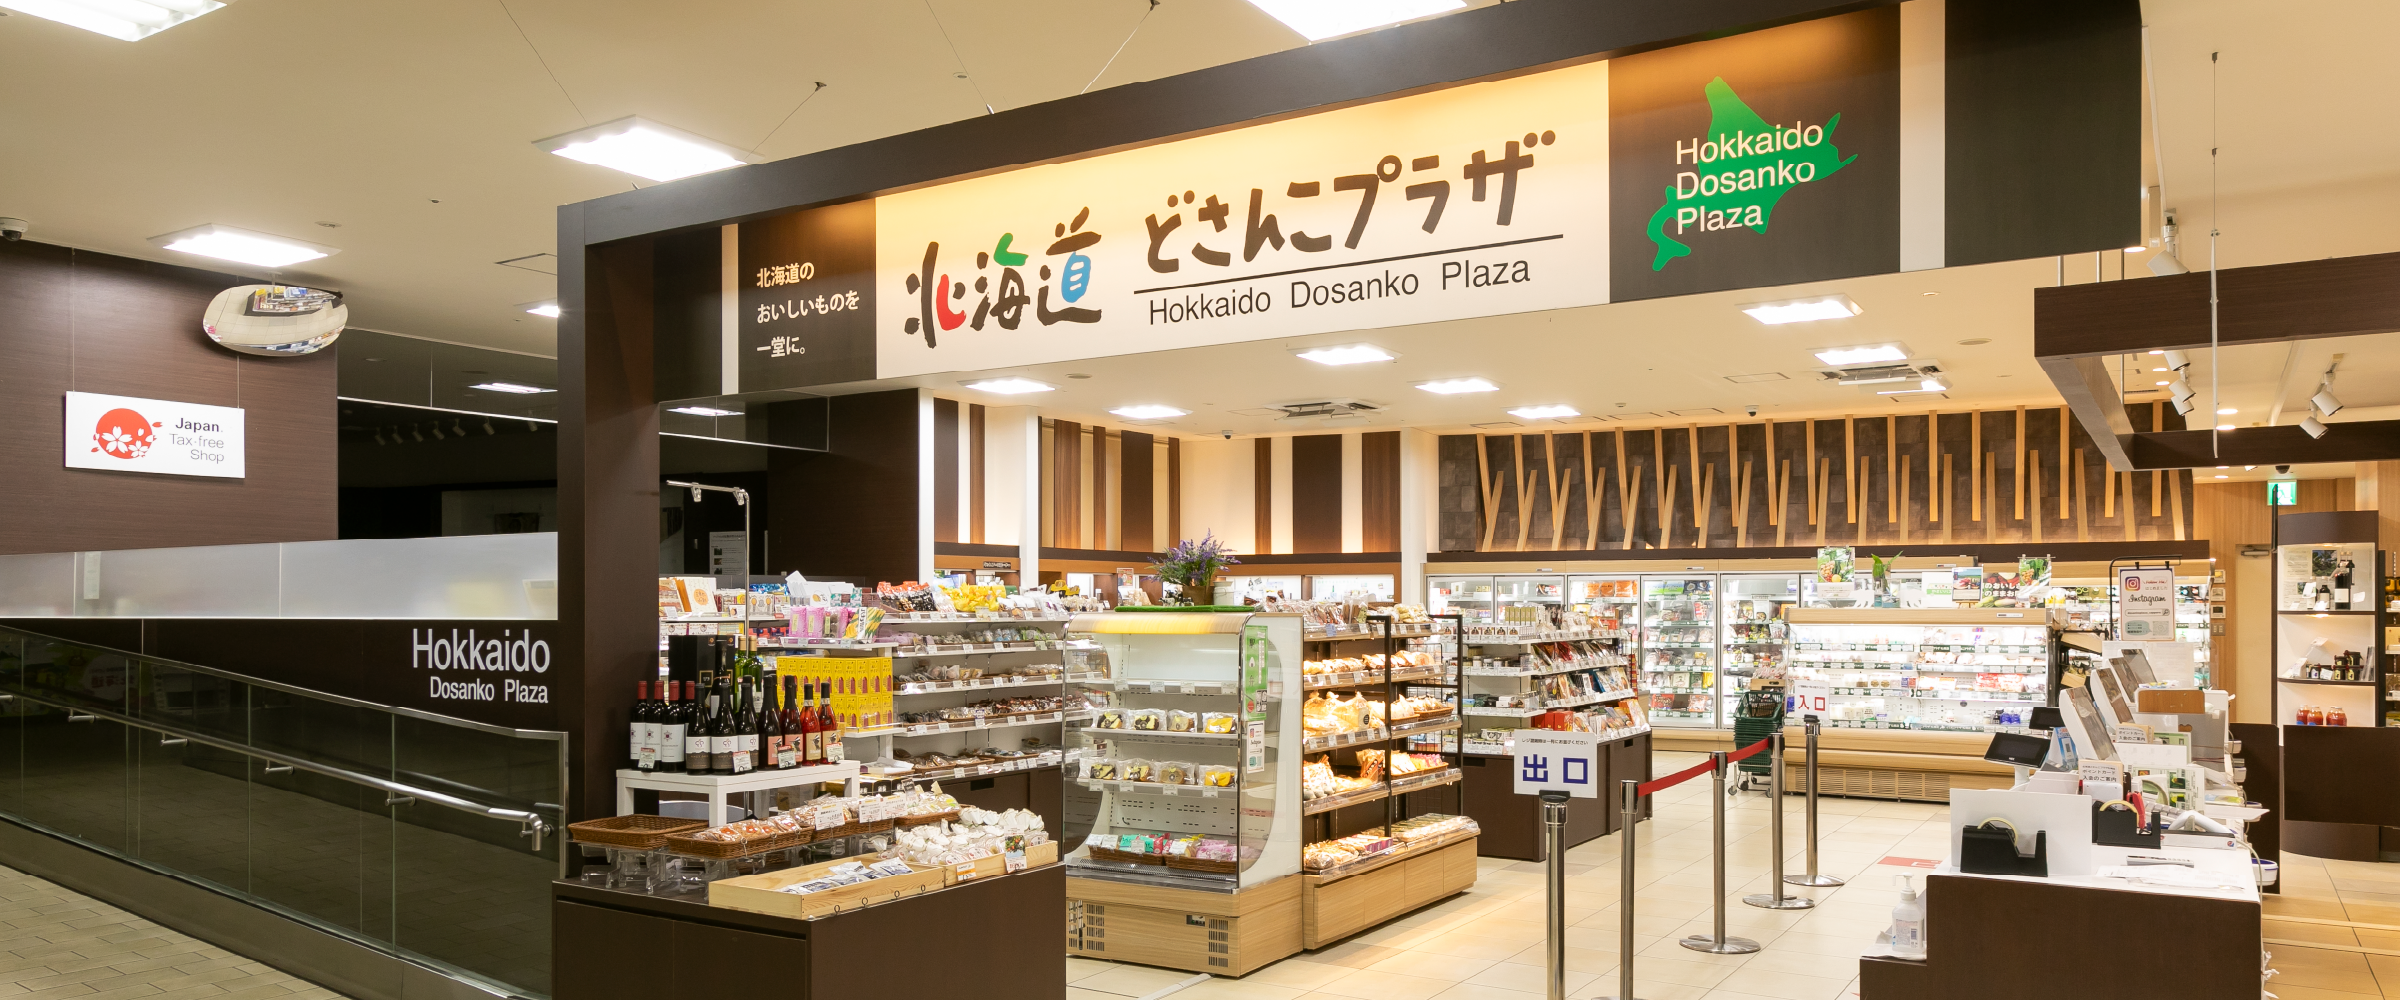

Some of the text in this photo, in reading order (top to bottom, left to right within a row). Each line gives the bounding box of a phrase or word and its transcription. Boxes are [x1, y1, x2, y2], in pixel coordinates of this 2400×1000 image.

[1675, 120, 1824, 167] Hokkaido
[1675, 160, 1816, 202] Dosanko
[1676, 199, 1764, 237] Plaza
[904, 131, 1557, 349] 北海道 どさんこプラザ
[756, 262, 815, 288] 北海道の
[1148, 254, 1532, 326] Hokkaido Dosanko Plaza
[756, 291, 860, 324] おいしいものを
[756, 335, 807, 357] 一堂に。
[190, 449, 225, 465] Shop
[2128, 594, 2166, 606] Instagram
[412, 628, 550, 673] Hokkaido
[430, 676, 548, 704] Dosanko Plaza
[1798, 694, 1825, 711] 入口
[1523, 753, 1588, 784] 出口
